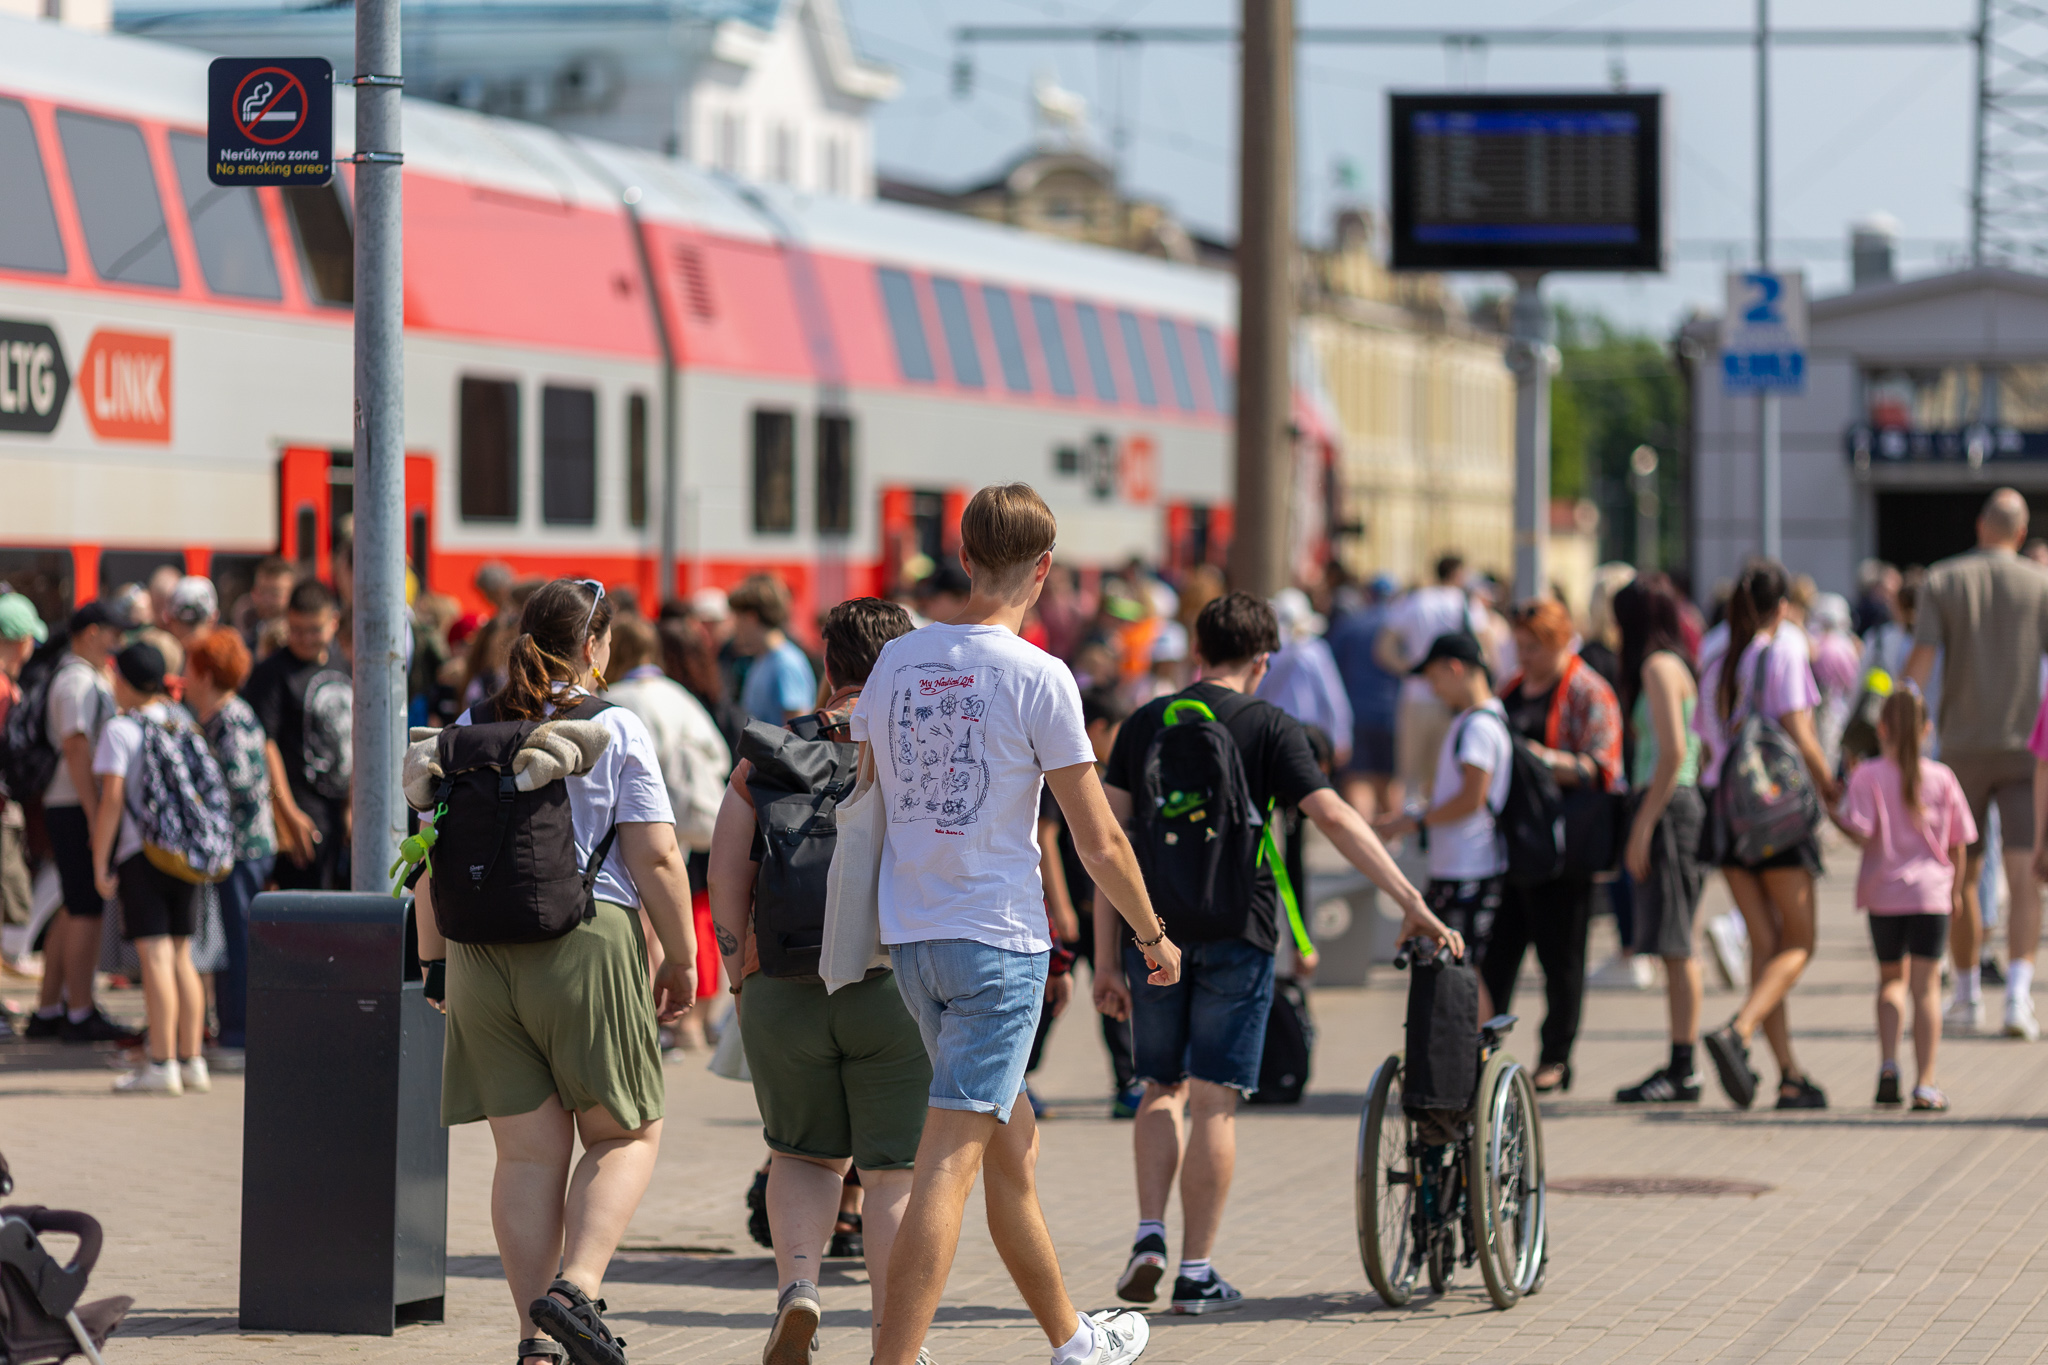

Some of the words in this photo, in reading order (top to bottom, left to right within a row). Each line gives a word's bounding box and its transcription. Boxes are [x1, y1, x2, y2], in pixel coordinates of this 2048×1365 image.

[220, 148, 286, 164] Nerūkymo
[288, 150, 319, 161] zona
[216, 162, 235, 175] No
[237, 161, 291, 178] smoking
[294, 164, 324, 175] area
[1744, 274, 1781, 322] 2
[0, 340, 57, 417] LTG
[94, 348, 166, 426] LINK
[919, 679, 934, 691] My
